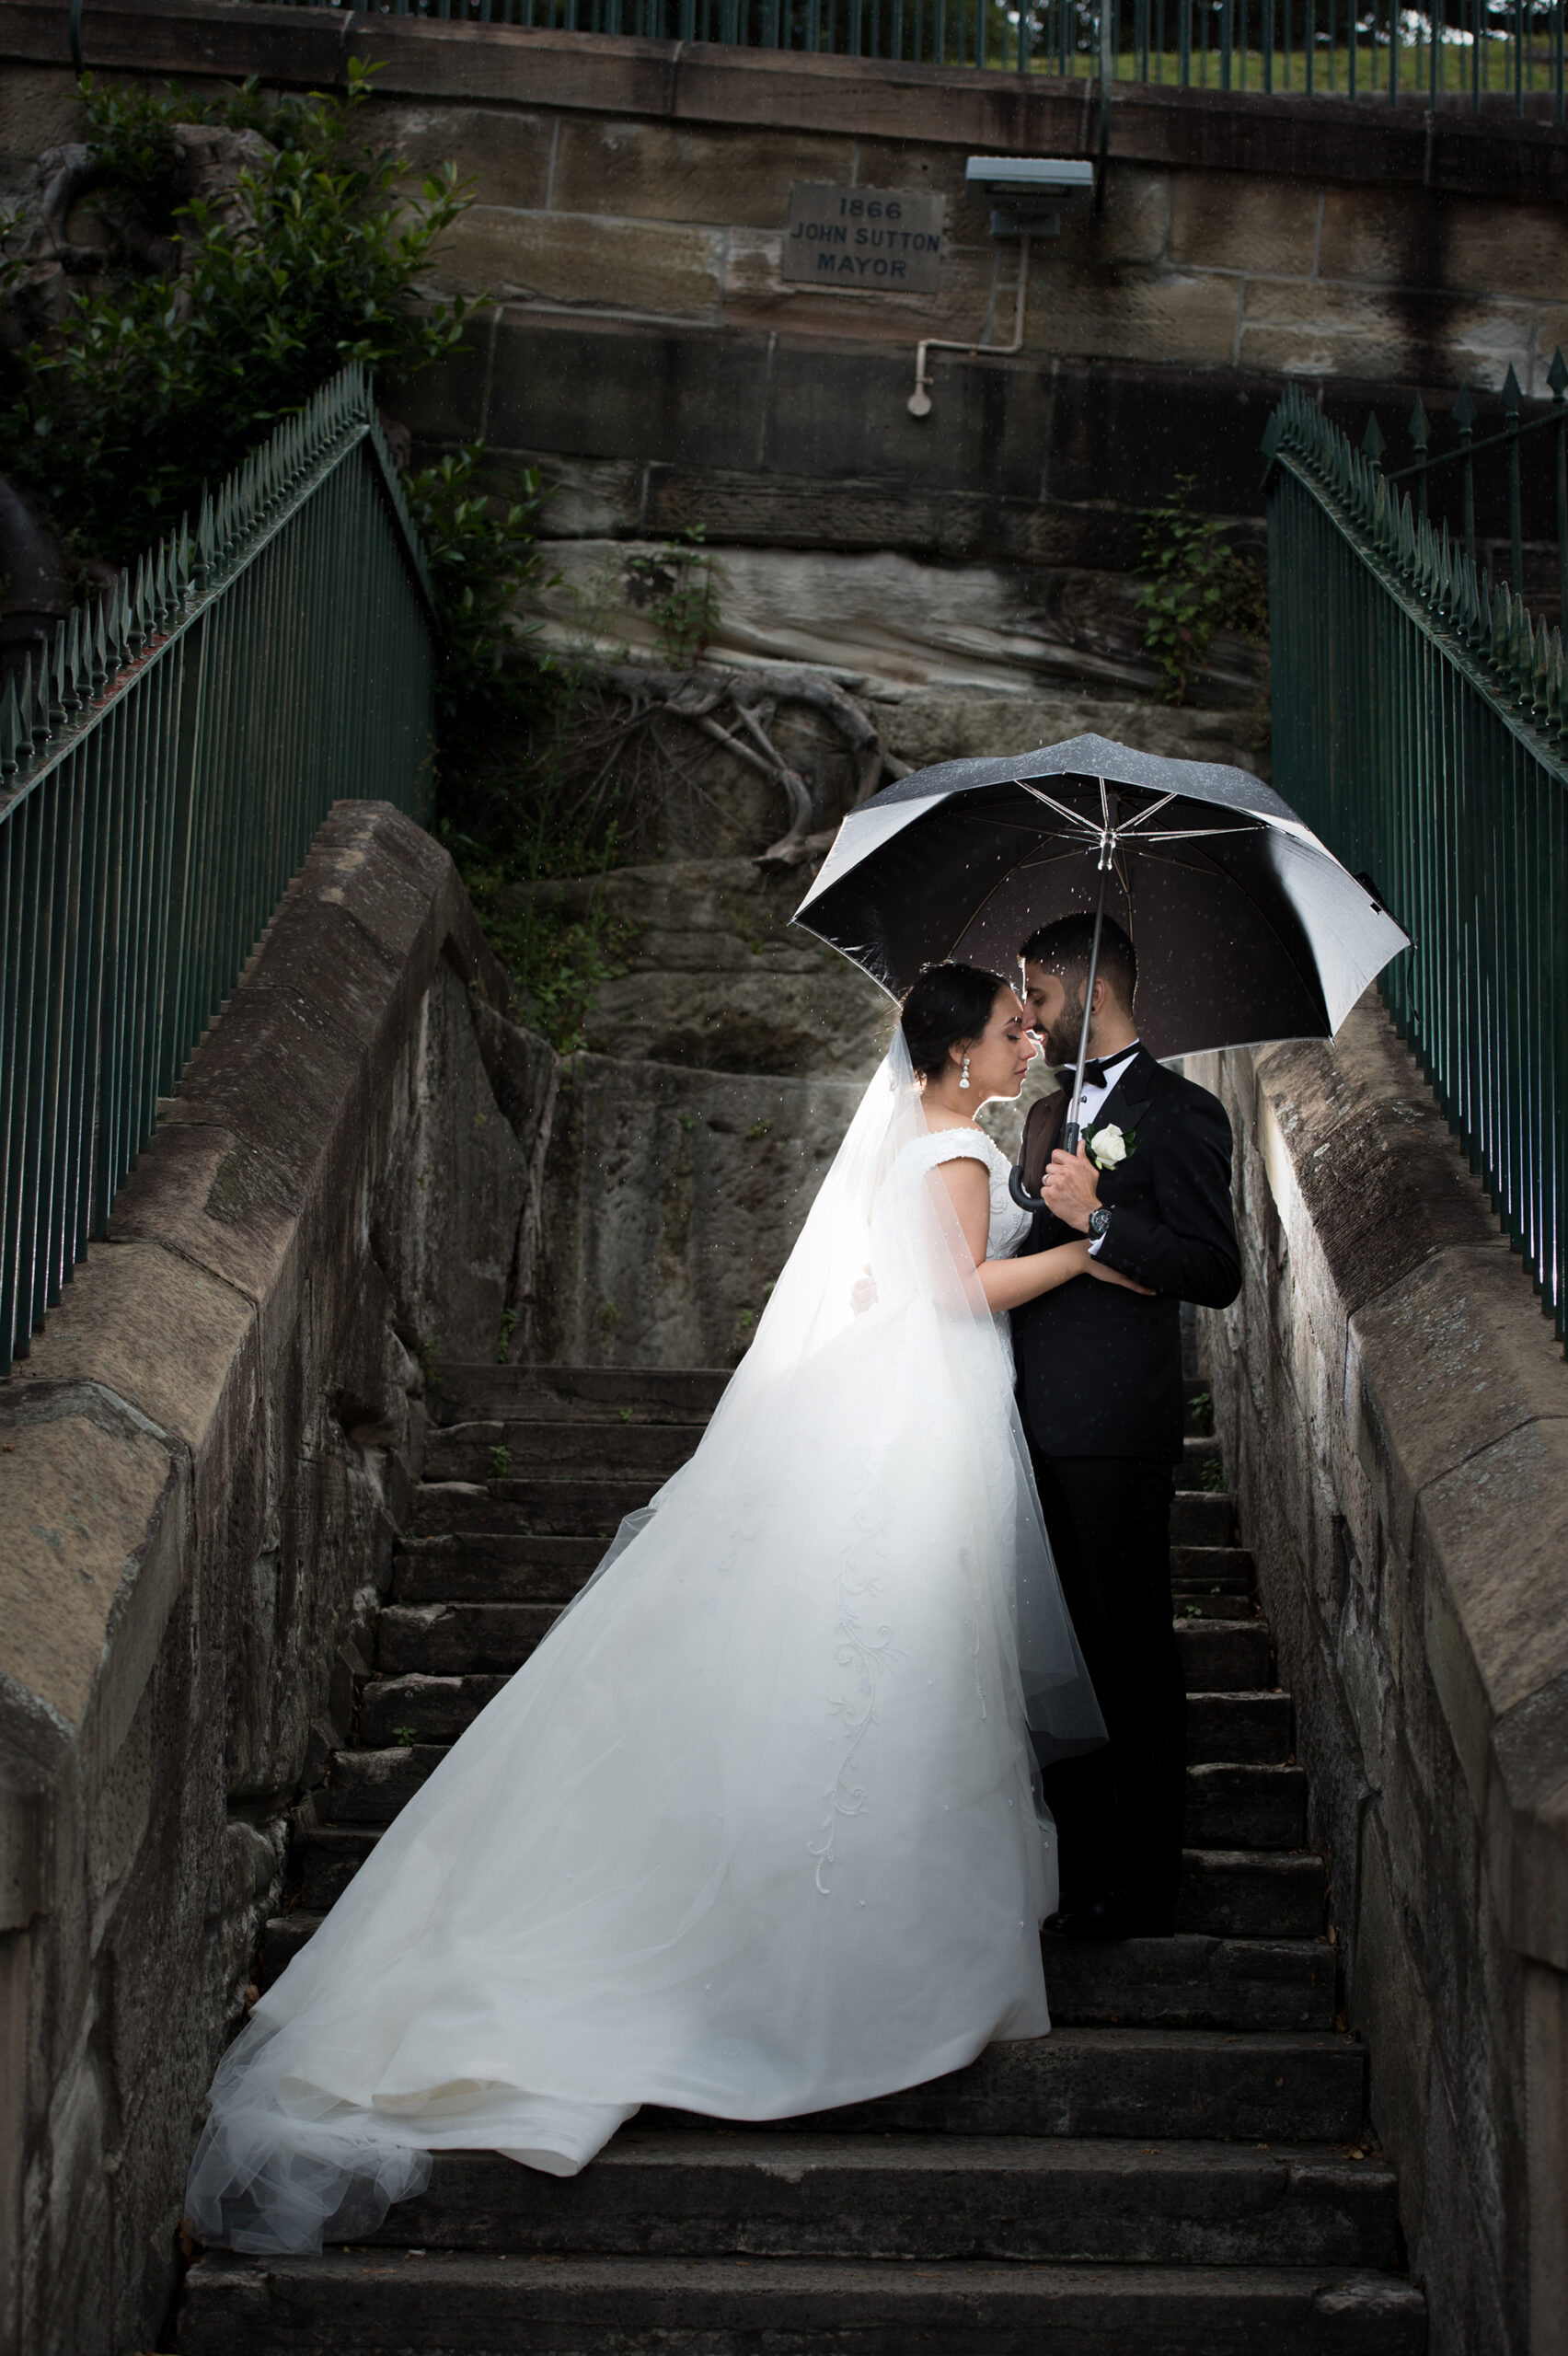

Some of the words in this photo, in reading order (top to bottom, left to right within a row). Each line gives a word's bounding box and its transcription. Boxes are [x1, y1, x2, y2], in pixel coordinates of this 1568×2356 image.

[839, 198, 902, 220] 1866
[791, 222, 847, 244] JOHN
[855, 227, 940, 253] SUTTON
[817, 253, 907, 278] MAYOR
